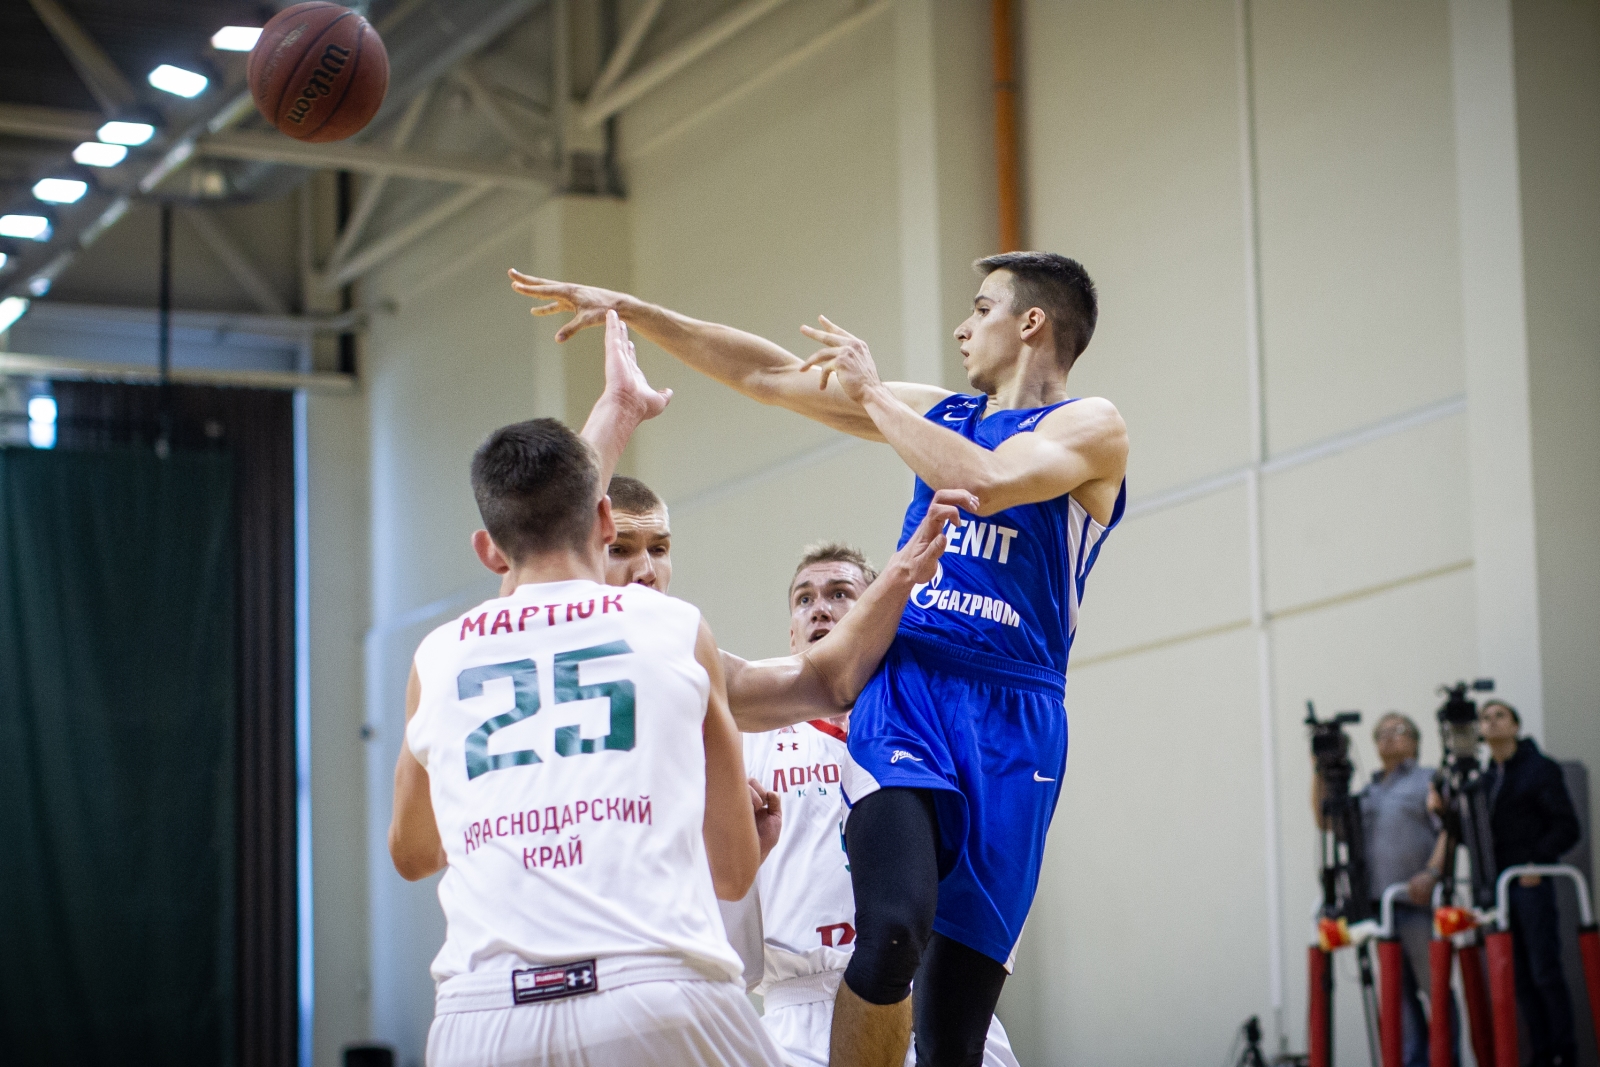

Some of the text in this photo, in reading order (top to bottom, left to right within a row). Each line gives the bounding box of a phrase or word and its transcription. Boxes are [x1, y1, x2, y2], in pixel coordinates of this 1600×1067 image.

[287, 43, 350, 124] Wilson
[942, 518, 1019, 565] ENIT
[459, 593, 625, 641] МАРТЮК
[937, 588, 1020, 628] GAZPROM
[456, 639, 636, 781] 25
[773, 763, 841, 793] ЛОКО
[463, 795, 653, 855] КРАСНОДАРСКИЙ
[523, 834, 583, 869] КРАЙ
